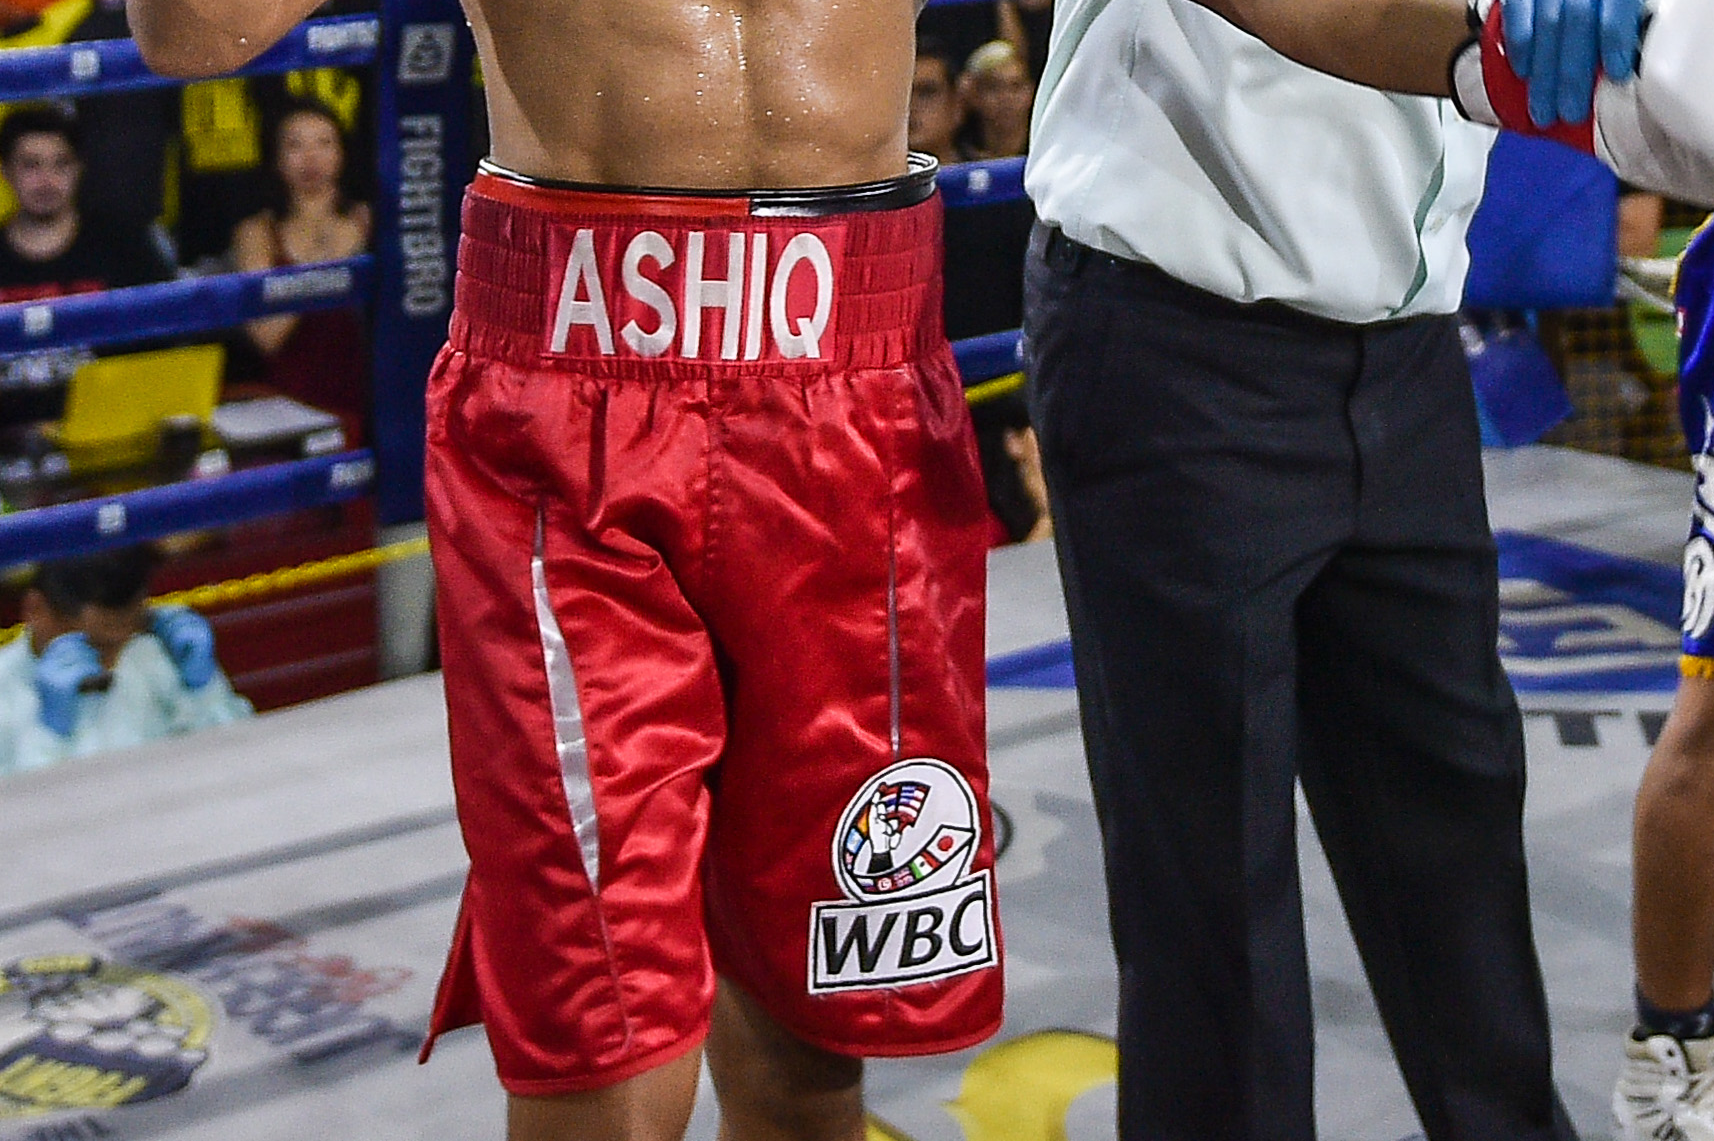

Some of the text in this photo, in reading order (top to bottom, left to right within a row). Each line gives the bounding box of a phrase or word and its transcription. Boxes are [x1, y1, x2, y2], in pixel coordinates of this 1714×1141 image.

[401, 113, 450, 316] FIGHTBRO
[549, 228, 834, 361] ASHIQ
[821, 890, 985, 975] WBC
